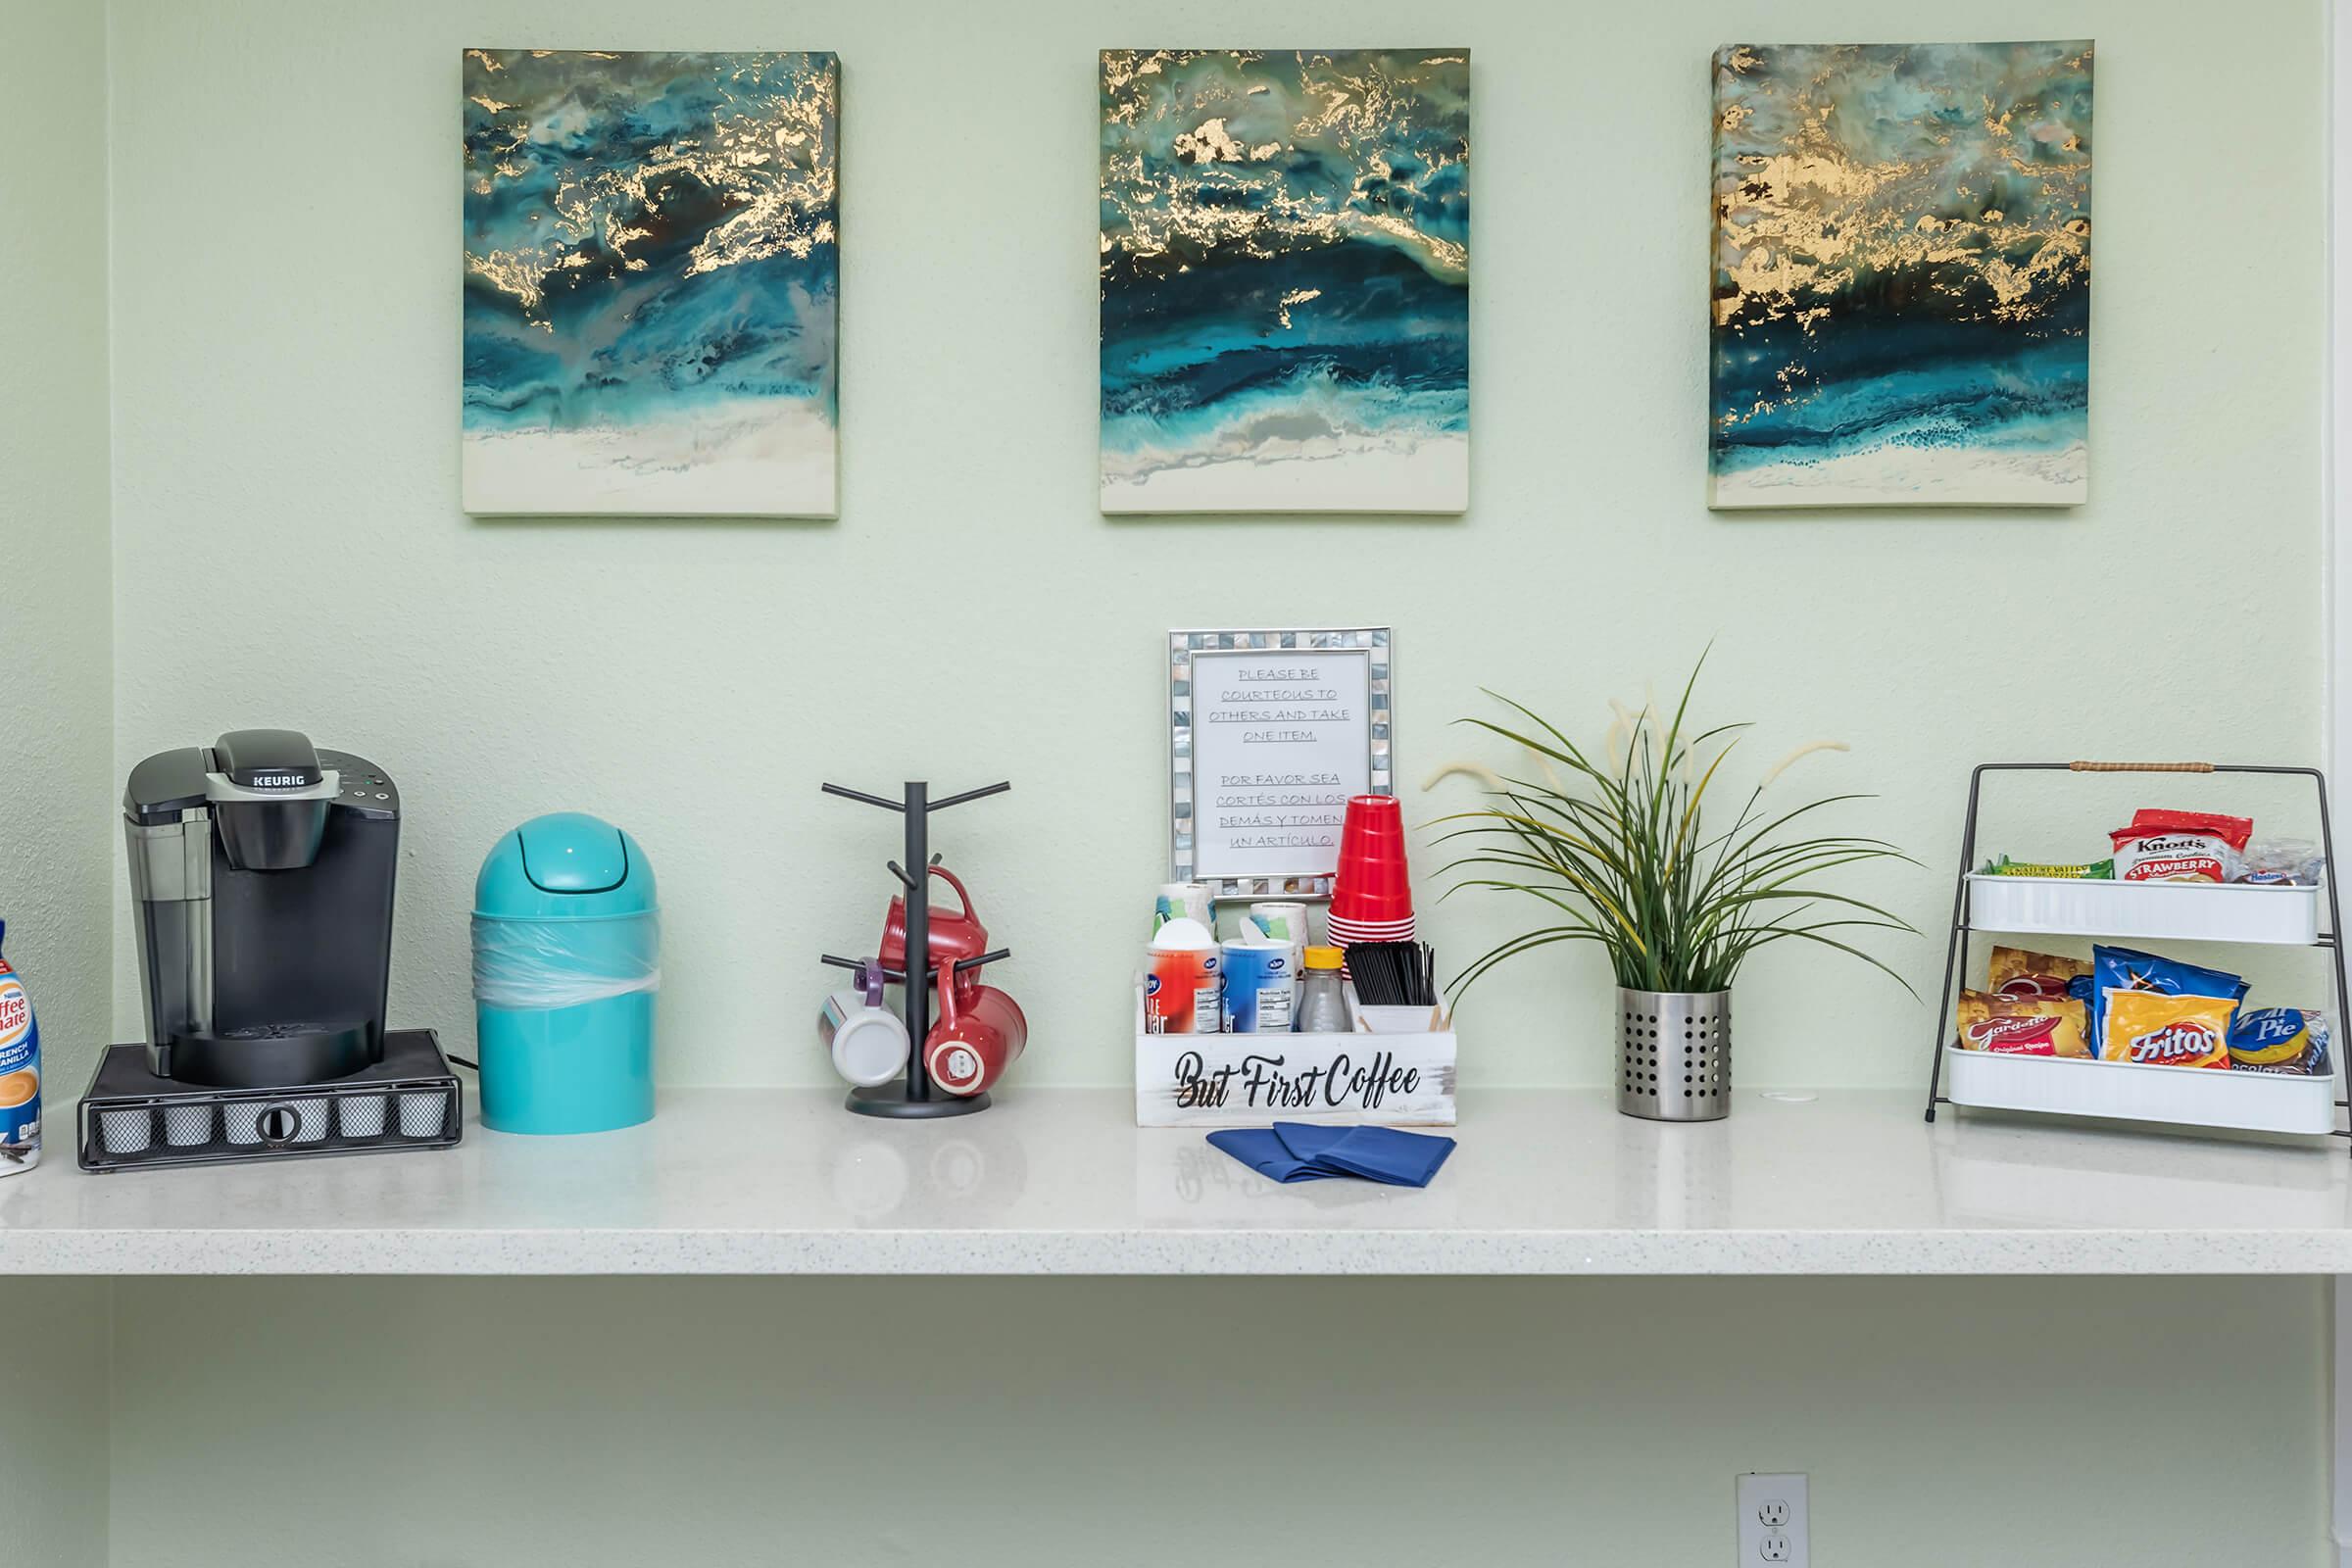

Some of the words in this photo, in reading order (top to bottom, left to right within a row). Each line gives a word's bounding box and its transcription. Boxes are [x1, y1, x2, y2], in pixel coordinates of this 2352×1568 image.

[1239, 669, 1295, 679] PLEASE
[1300, 669, 1318, 679] BE
[1221, 690, 1313, 701] COURTEOUS
[1317, 689, 1337, 699] TO
[1208, 710, 1271, 721] OTHERS
[1276, 710, 1307, 720] AND
[1309, 709, 1349, 719] TAKE
[1244, 731, 1274, 742] ONE
[1278, 730, 1316, 741] ITEM.
[254, 775, 305, 786] KEURIG
[1221, 775, 1251, 785] POR
[1255, 774, 1304, 785] FAVOR
[1309, 773, 1341, 784] SEA
[1216, 792, 1276, 806] CORTÉS
[1280, 795, 1310, 805] CON
[1316, 794, 1346, 805] LOS
[1219, 812, 1273, 826] DEMÁS
[1277, 815, 1287, 828] Y
[1291, 814, 1343, 825] TOMEN
[1230, 838, 1251, 848] UN
[2137, 837, 2207, 853] Knott's
[2130, 859, 2217, 880] STRAWBERRY
[2256, 1019, 2297, 1042] Pie
[0, 1041, 28, 1058] RENCH
[2130, 1026, 2216, 1062] Fritos
[0, 1050, 29, 1067] ANILLA
[1175, 1051, 1241, 1109] But
[1241, 1054, 1327, 1108] First
[1323, 1051, 1421, 1109] Coffee
